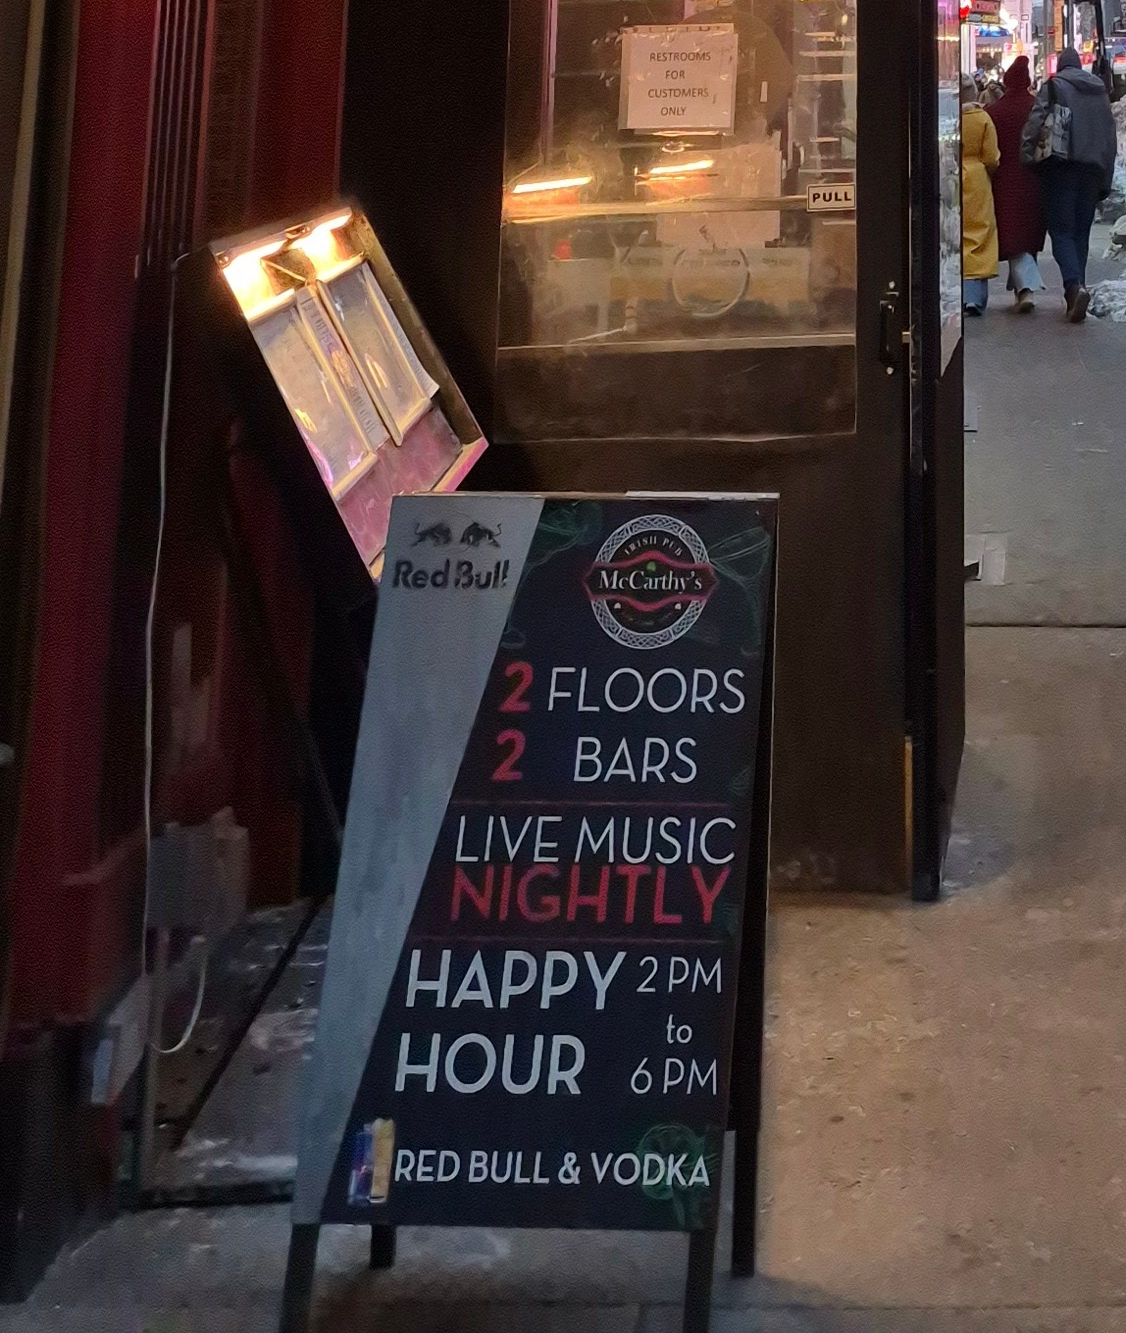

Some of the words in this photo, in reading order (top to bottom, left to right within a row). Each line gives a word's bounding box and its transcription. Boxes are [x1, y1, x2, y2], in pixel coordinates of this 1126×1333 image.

[649, 52, 711, 62] RESTROOMS
[665, 70, 686, 80] FOR
[648, 88, 709, 98] CUSTOMERS
[660, 107, 687, 116] ONLY
[811, 191, 852, 204] PULL
[624, 536, 657, 556] IRISH
[662, 538, 684, 557] PUB
[393, 558, 450, 590] Red
[454, 559, 510, 590] Bull
[599, 570, 702, 595] McCarthy's
[501, 661, 534, 712] 2
[548, 667, 746, 713] FLOORS
[492, 729, 526, 782] 2
[573, 736, 698, 784] BARS
[455, 815, 563, 863] LIVE
[574, 816, 737, 865] MUSIC
[451, 865, 731, 925] NIGHTLY
[405, 949, 627, 1011] HAPPY
[666, 1014, 693, 1045] to
[395, 1033, 586, 1096] HOUR
[395, 1149, 461, 1184] RED
[468, 1151, 554, 1184] BULL
[558, 1153, 582, 1185] &
[591, 1152, 711, 1187] VODKA
